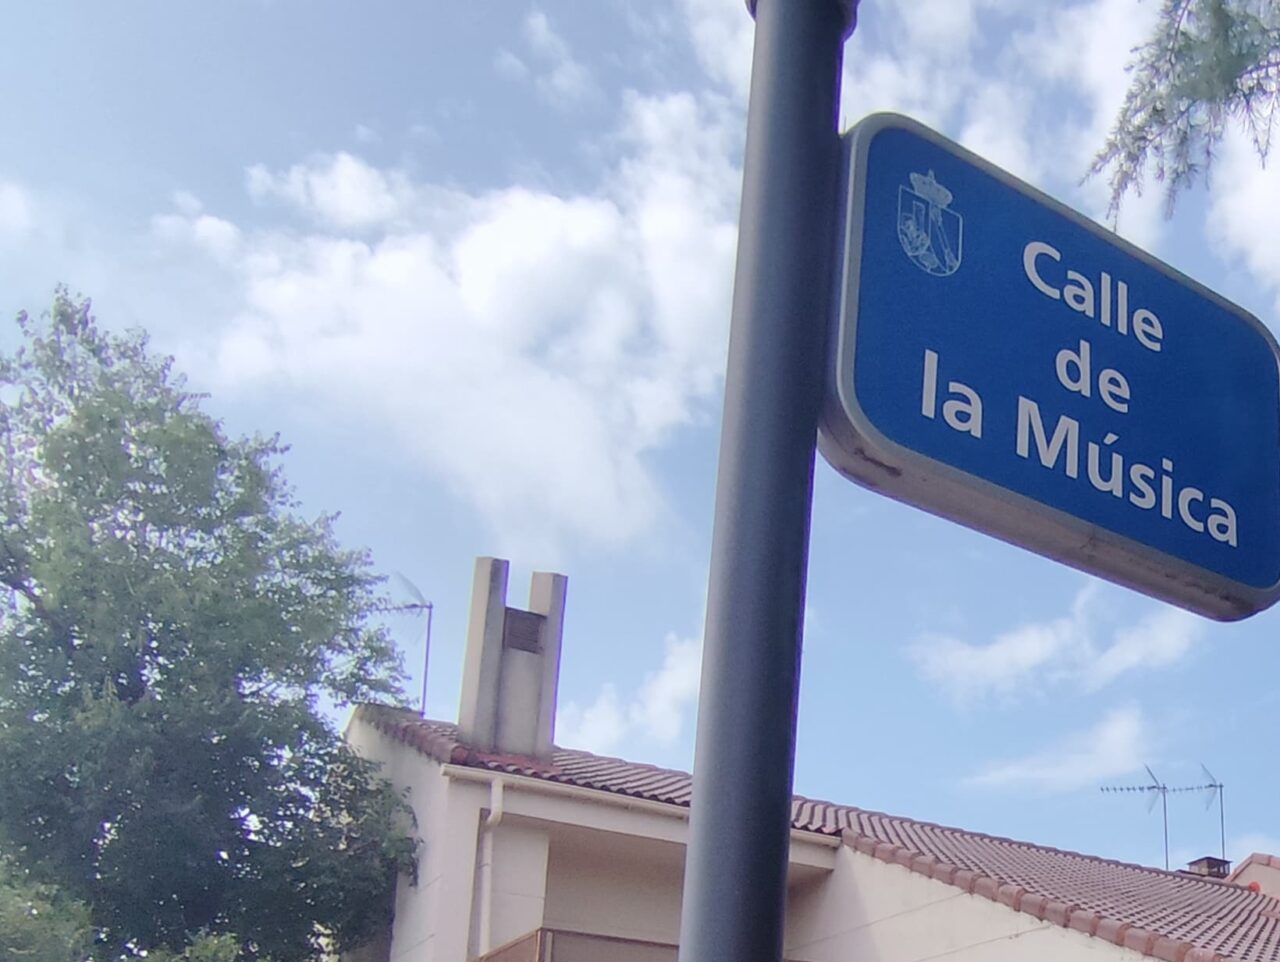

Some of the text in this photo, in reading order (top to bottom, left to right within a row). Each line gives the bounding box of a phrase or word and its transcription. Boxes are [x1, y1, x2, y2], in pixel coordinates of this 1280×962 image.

[1023, 241, 1164, 352] Calle
[1055, 339, 1131, 414] de
[921, 349, 1238, 547] la Música
